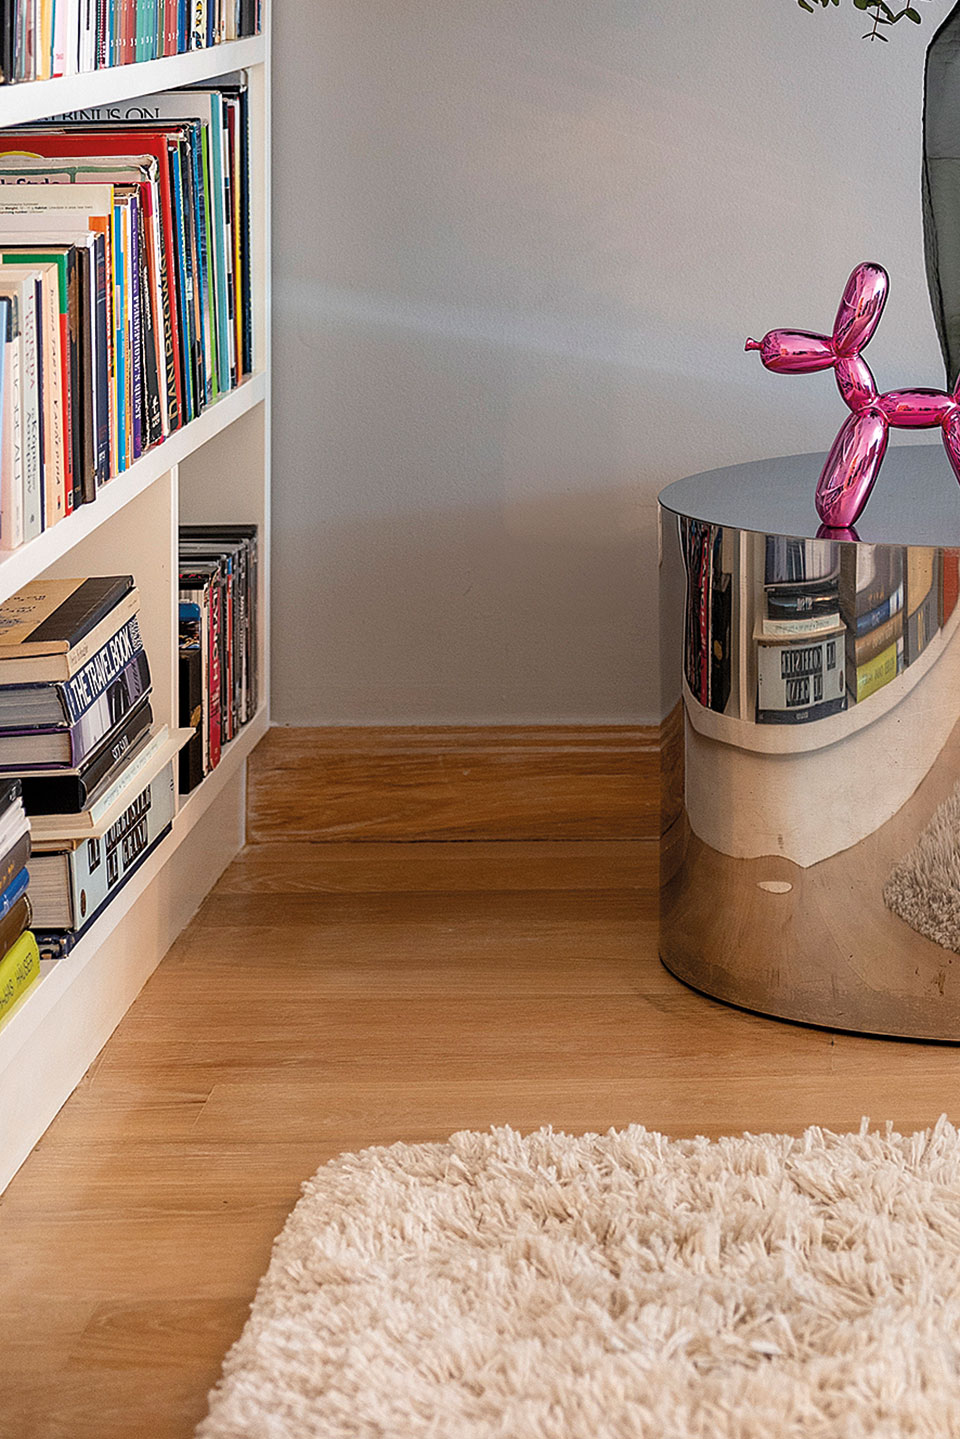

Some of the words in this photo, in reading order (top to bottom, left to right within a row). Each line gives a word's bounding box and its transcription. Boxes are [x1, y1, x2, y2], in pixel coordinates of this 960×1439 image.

[133, 295, 141, 383] PERSEPHONE'S
[161, 253, 173, 357] BROWN
[166, 360, 178, 420] DAN
[70, 670, 92, 714] THE
[85, 647, 116, 698] TRAVEL
[110, 625, 134, 669] BOOK
[122, 820, 149, 866] GRAND
